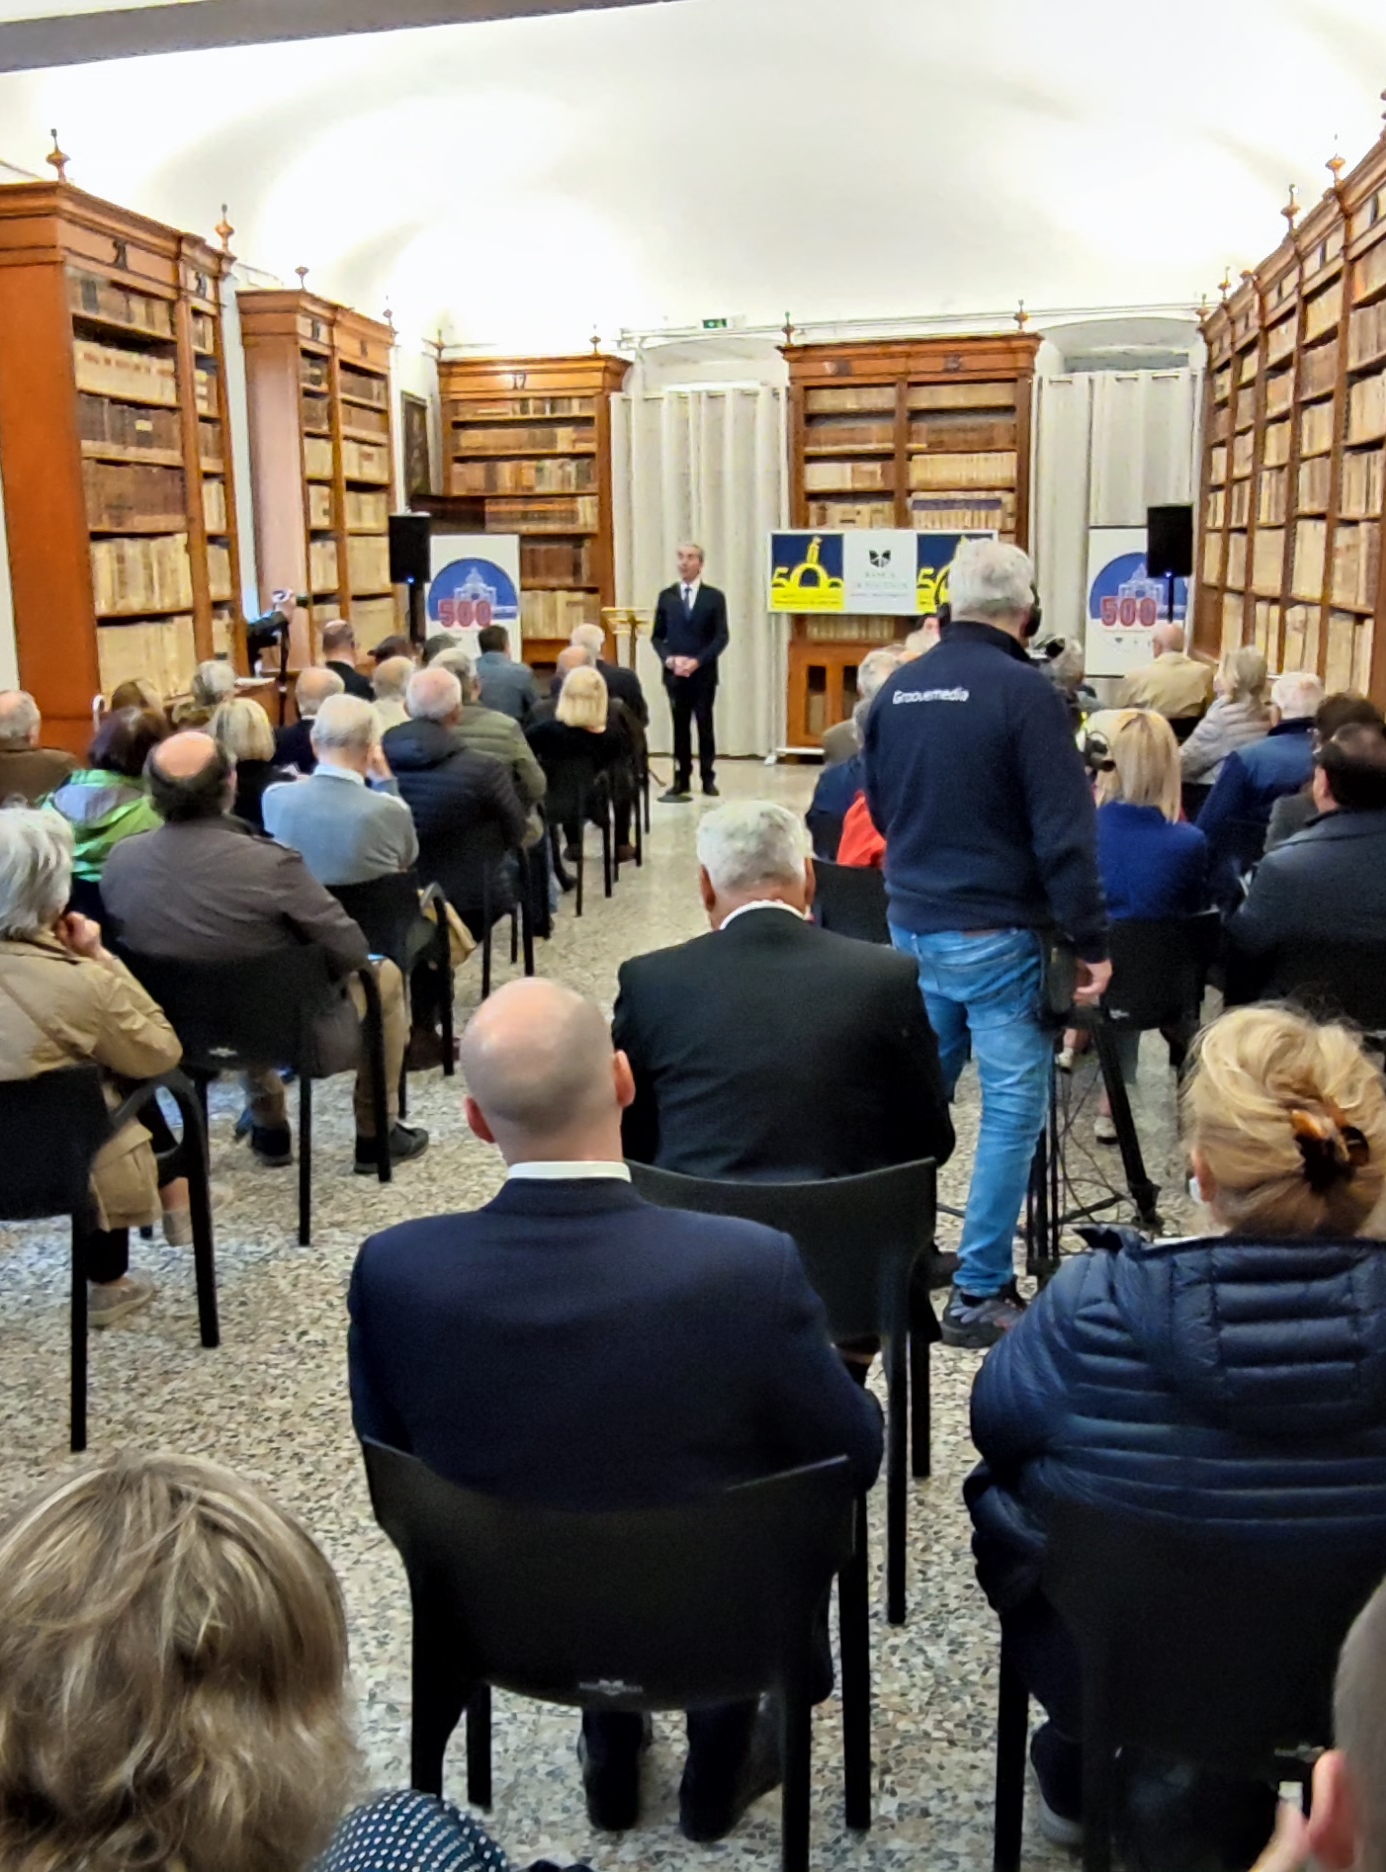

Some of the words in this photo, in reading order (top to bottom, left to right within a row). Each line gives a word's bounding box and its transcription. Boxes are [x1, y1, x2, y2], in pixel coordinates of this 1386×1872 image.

[511, 372, 527, 391] 17
[438, 599, 492, 629] 500
[1100, 597, 1157, 627] 500
[892, 687, 970, 704] Groovemedia
